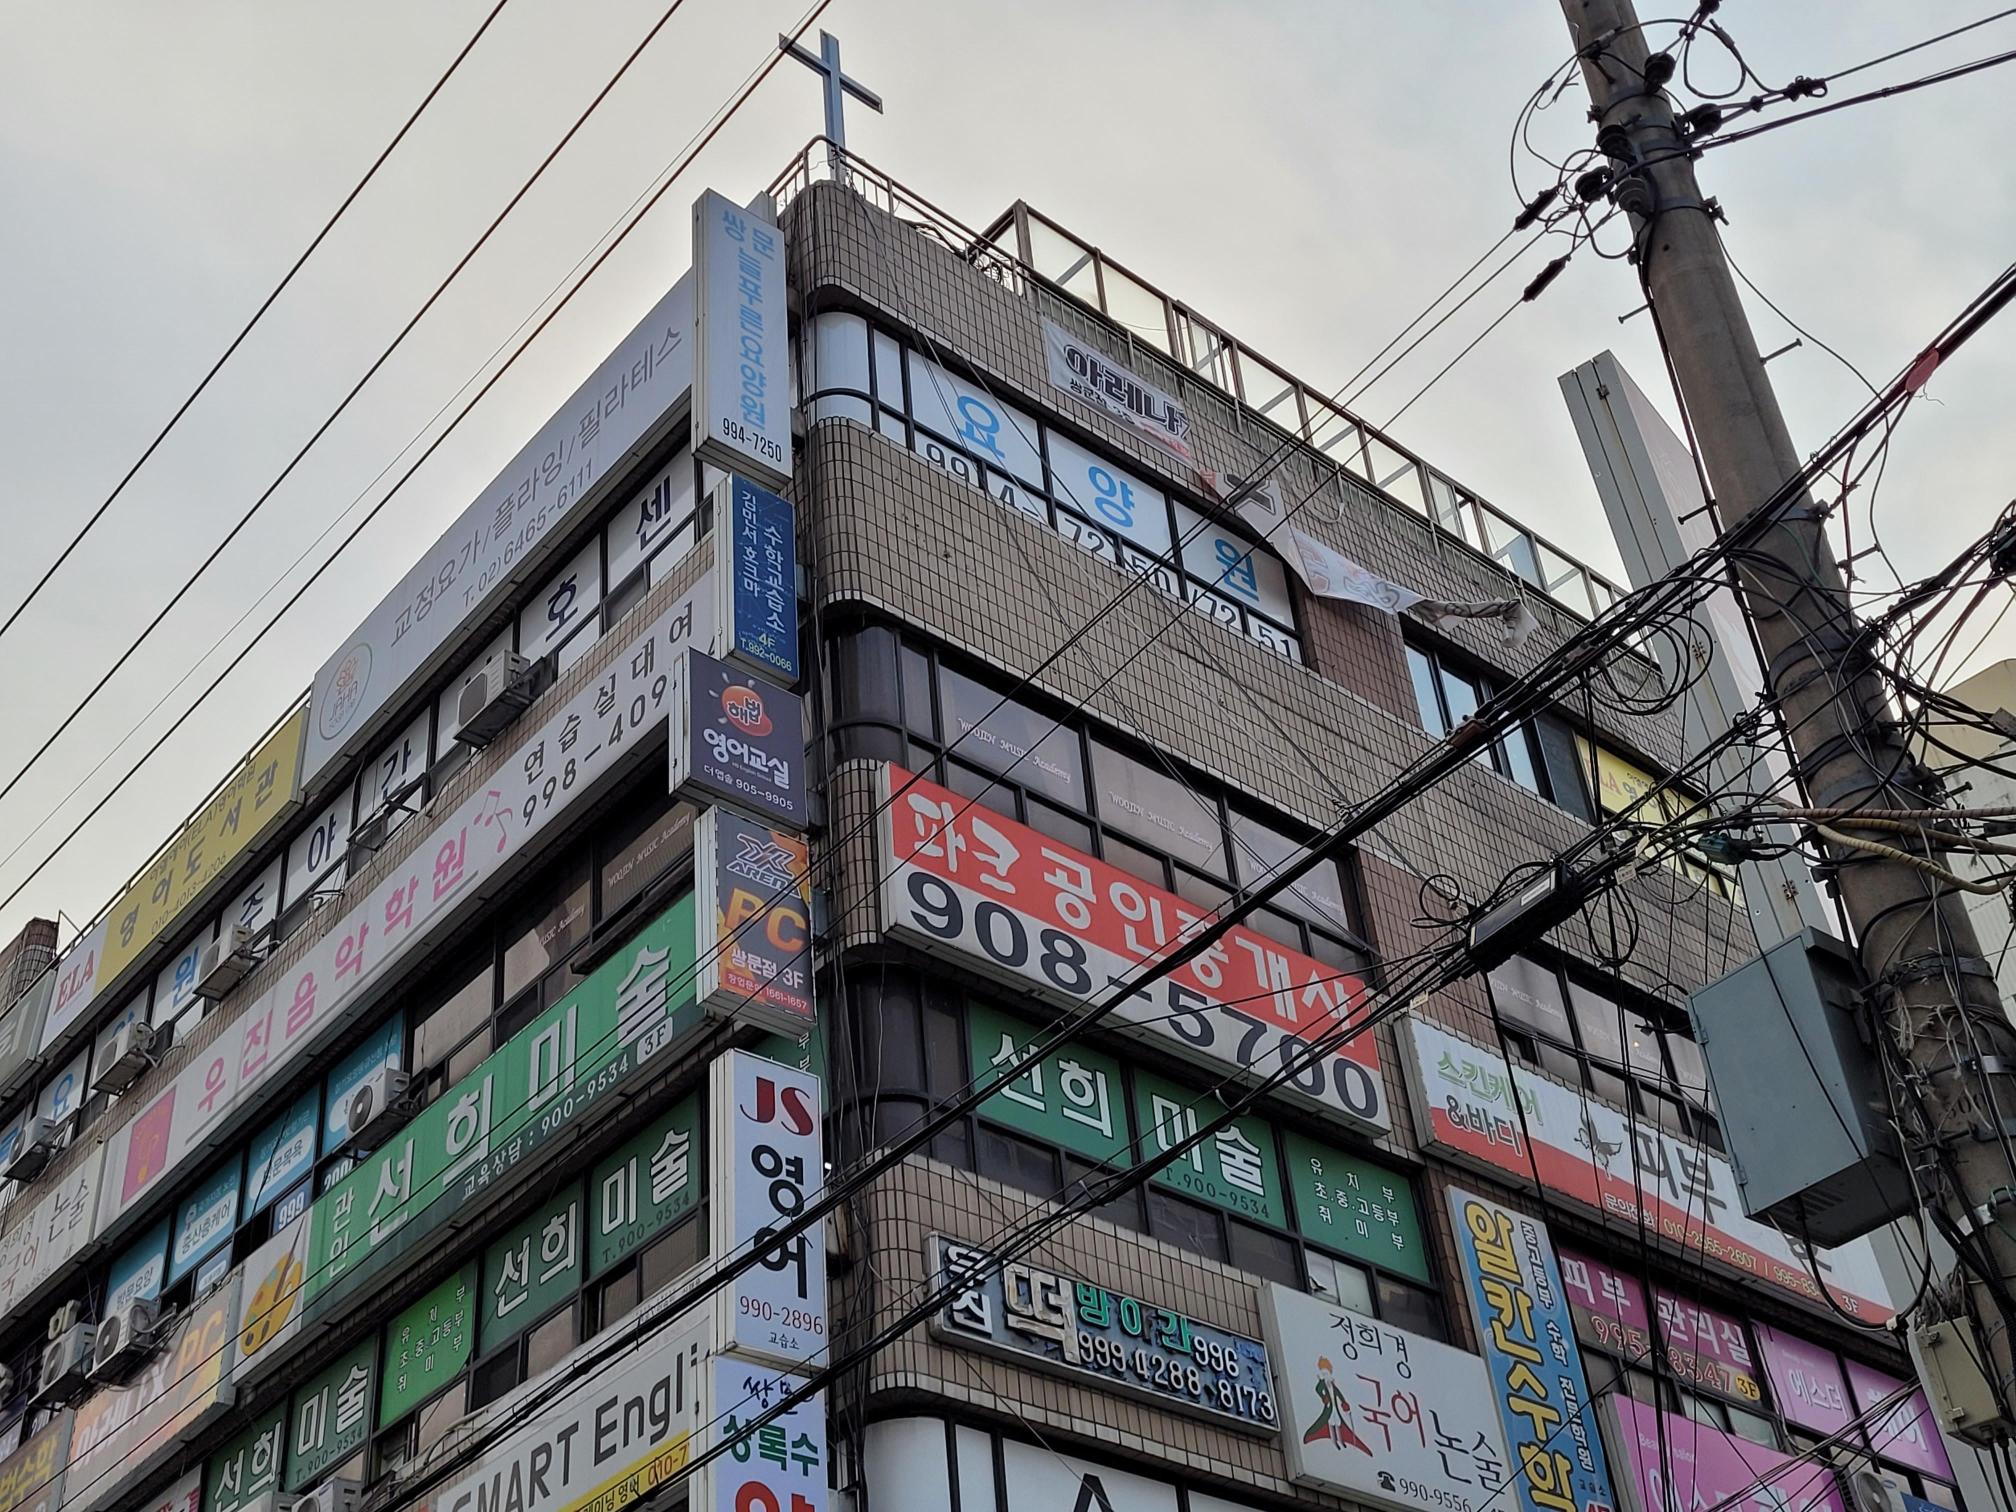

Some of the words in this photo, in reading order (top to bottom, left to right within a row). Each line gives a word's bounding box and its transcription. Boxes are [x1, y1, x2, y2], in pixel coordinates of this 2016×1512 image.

[722, 417, 783, 463] 994-7250
[635, 475, 672, 552] 센
[956, 394, 1006, 460] 요
[1088, 465, 1136, 529] 양
[1214, 538, 1260, 602] 원
[545, 572, 580, 643] 호
[763, 524, 787, 635] 수학교습소
[758, 632, 777, 649] 4F
[727, 696, 762, 726] 해법
[702, 728, 791, 791] 영어교실
[735, 777, 794, 811] 905-9905
[307, 812, 336, 873] 야
[726, 859, 803, 899] ARENA
[724, 886, 806, 955] PC
[1040, 845, 1356, 1049] 공인중개사
[54, 949, 94, 1016] ELA
[731, 948, 778, 982] 쌍문점
[782, 967, 804, 990] 3F
[905, 871, 1380, 1120] 908-5700
[644, 1024, 667, 1056] 3F
[368, 1072, 494, 1248] 선희
[527, 944, 673, 1113] 미술
[739, 1075, 815, 1137] JS
[989, 1031, 1115, 1140] 선희
[1151, 1093, 1266, 1198] 미술
[1436, 1051, 1544, 1127] 스킨케어
[461, 1136, 523, 1202] 교육상담
[541, 1051, 630, 1133] 900-9534
[1445, 1094, 1524, 1158] &바디
[1622, 1122, 1727, 1225] 피부
[277, 1191, 305, 1232] 999
[493, 1200, 579, 1319] 선희
[599, 1127, 693, 1237] 미술
[750, 1143, 808, 1301] 영어
[739, 1294, 824, 1336] 990-2896
[767, 1330, 801, 1351] 교습소
[1002, 1258, 1081, 1365] 떡
[1545, 1318, 1569, 1369] 수학
[1559, 1255, 1632, 1317] 피부
[1656, 1294, 1752, 1368] 관리실
[1328, 1312, 1413, 1380] 정희경
[1355, 1372, 1427, 1453] 국어
[1736, 1375, 1757, 1397] 3F
[212, 1419, 284, 1512] 선희
[296, 1364, 369, 1456] 미술
[722, 1413, 820, 1478] 상록수
[1428, 1408, 1506, 1495] 논술
[1399, 1477, 1473, 1512] 990-9556
